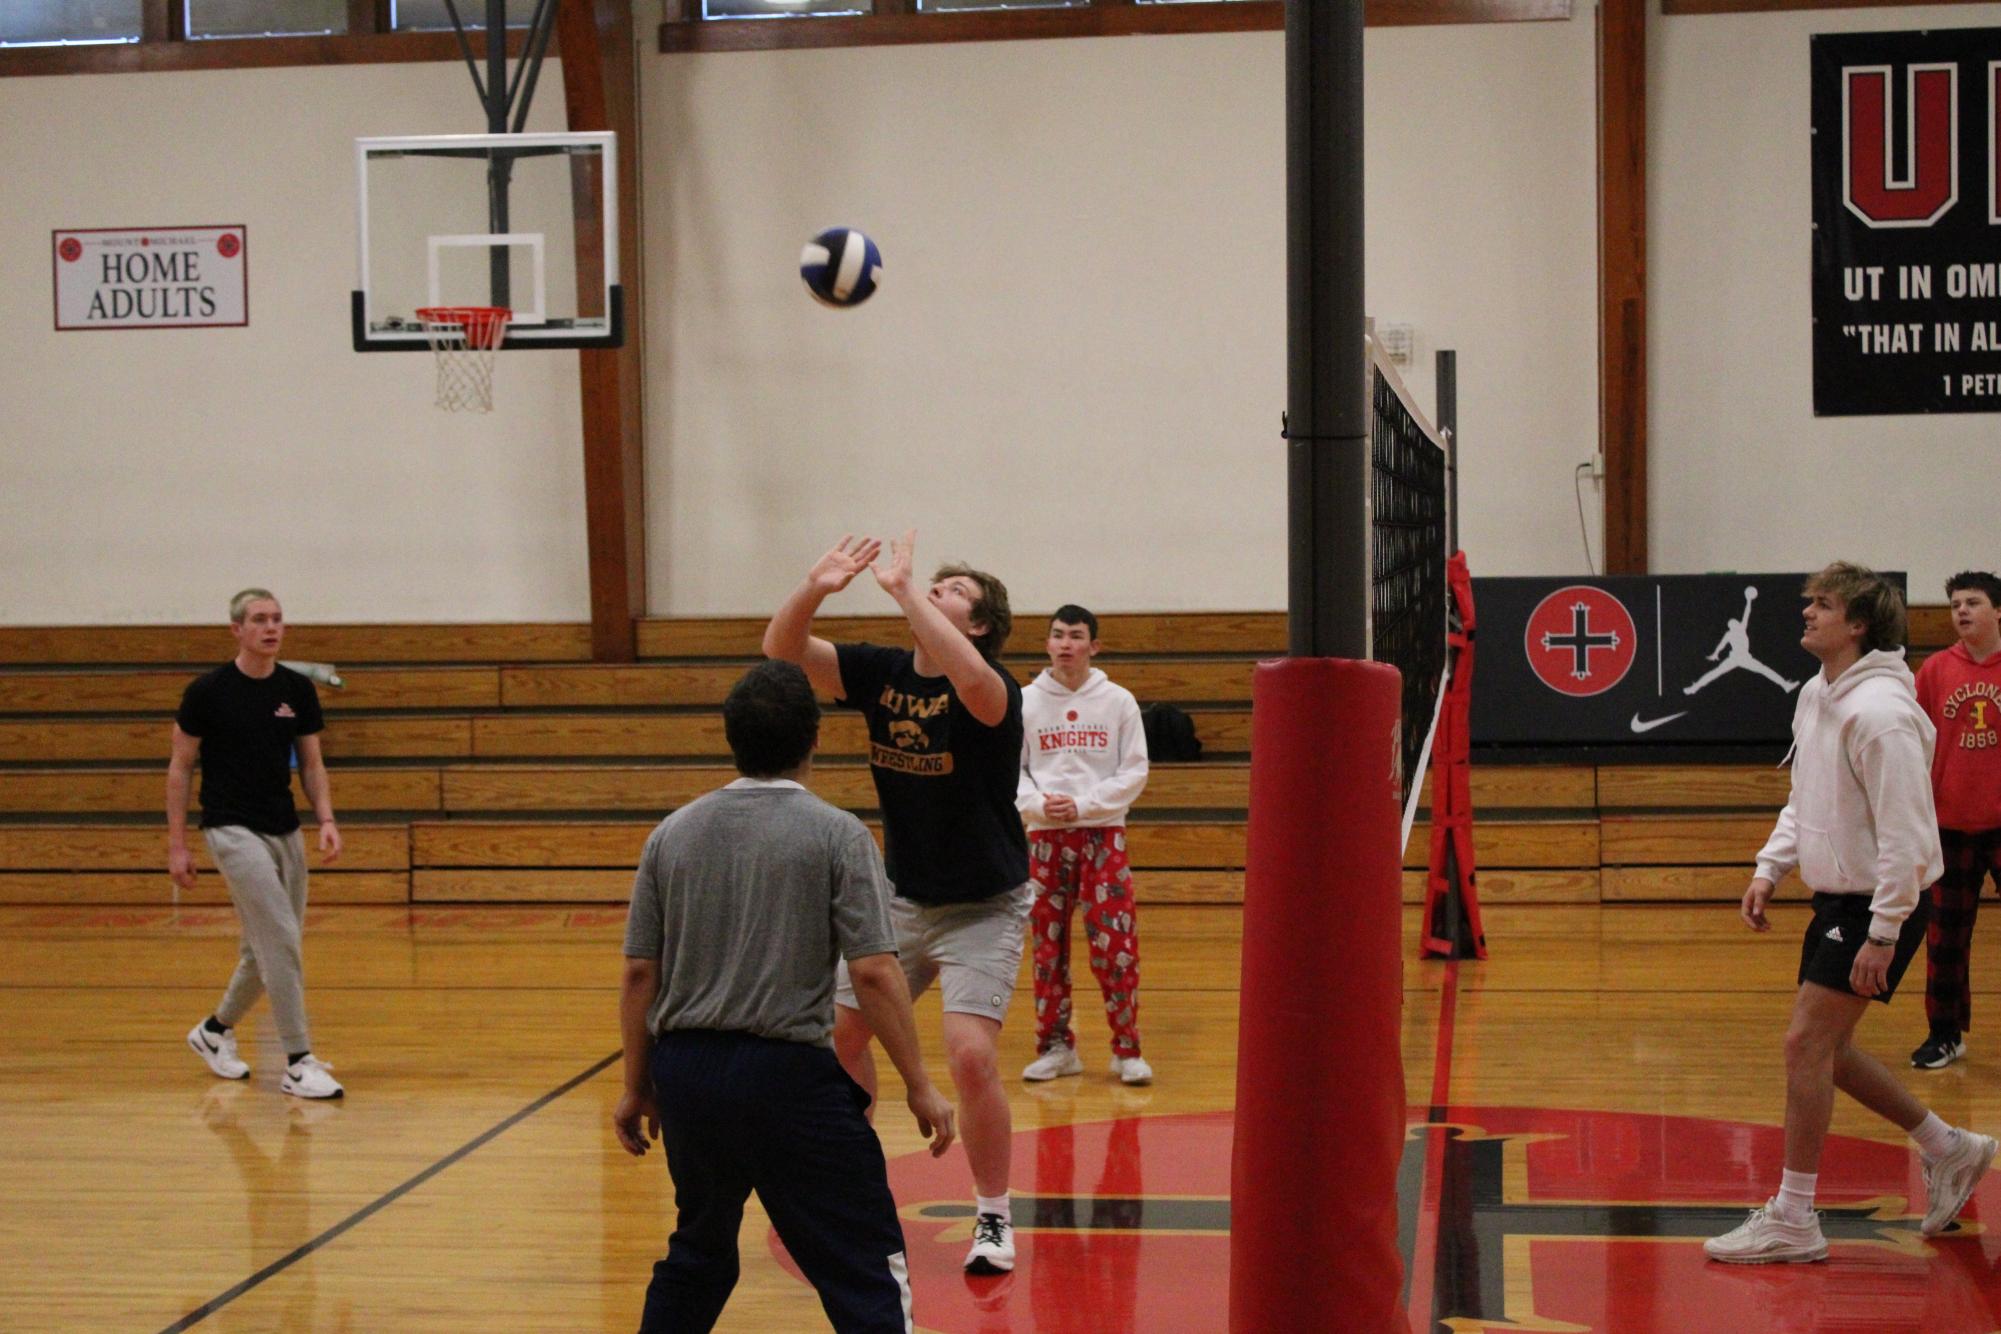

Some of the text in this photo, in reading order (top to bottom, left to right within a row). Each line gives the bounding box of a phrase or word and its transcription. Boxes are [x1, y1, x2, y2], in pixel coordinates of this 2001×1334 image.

[102, 252, 202, 284] HOME
[1843, 263, 2001, 301] UT IN OM
[87, 286, 217, 320] ADULTS
[1934, 322, 1960, 353] IN
[1943, 374, 1952, 397] 1
[1039, 730, 1108, 751] KNIGHTS
[1959, 730, 1998, 748] 1858
